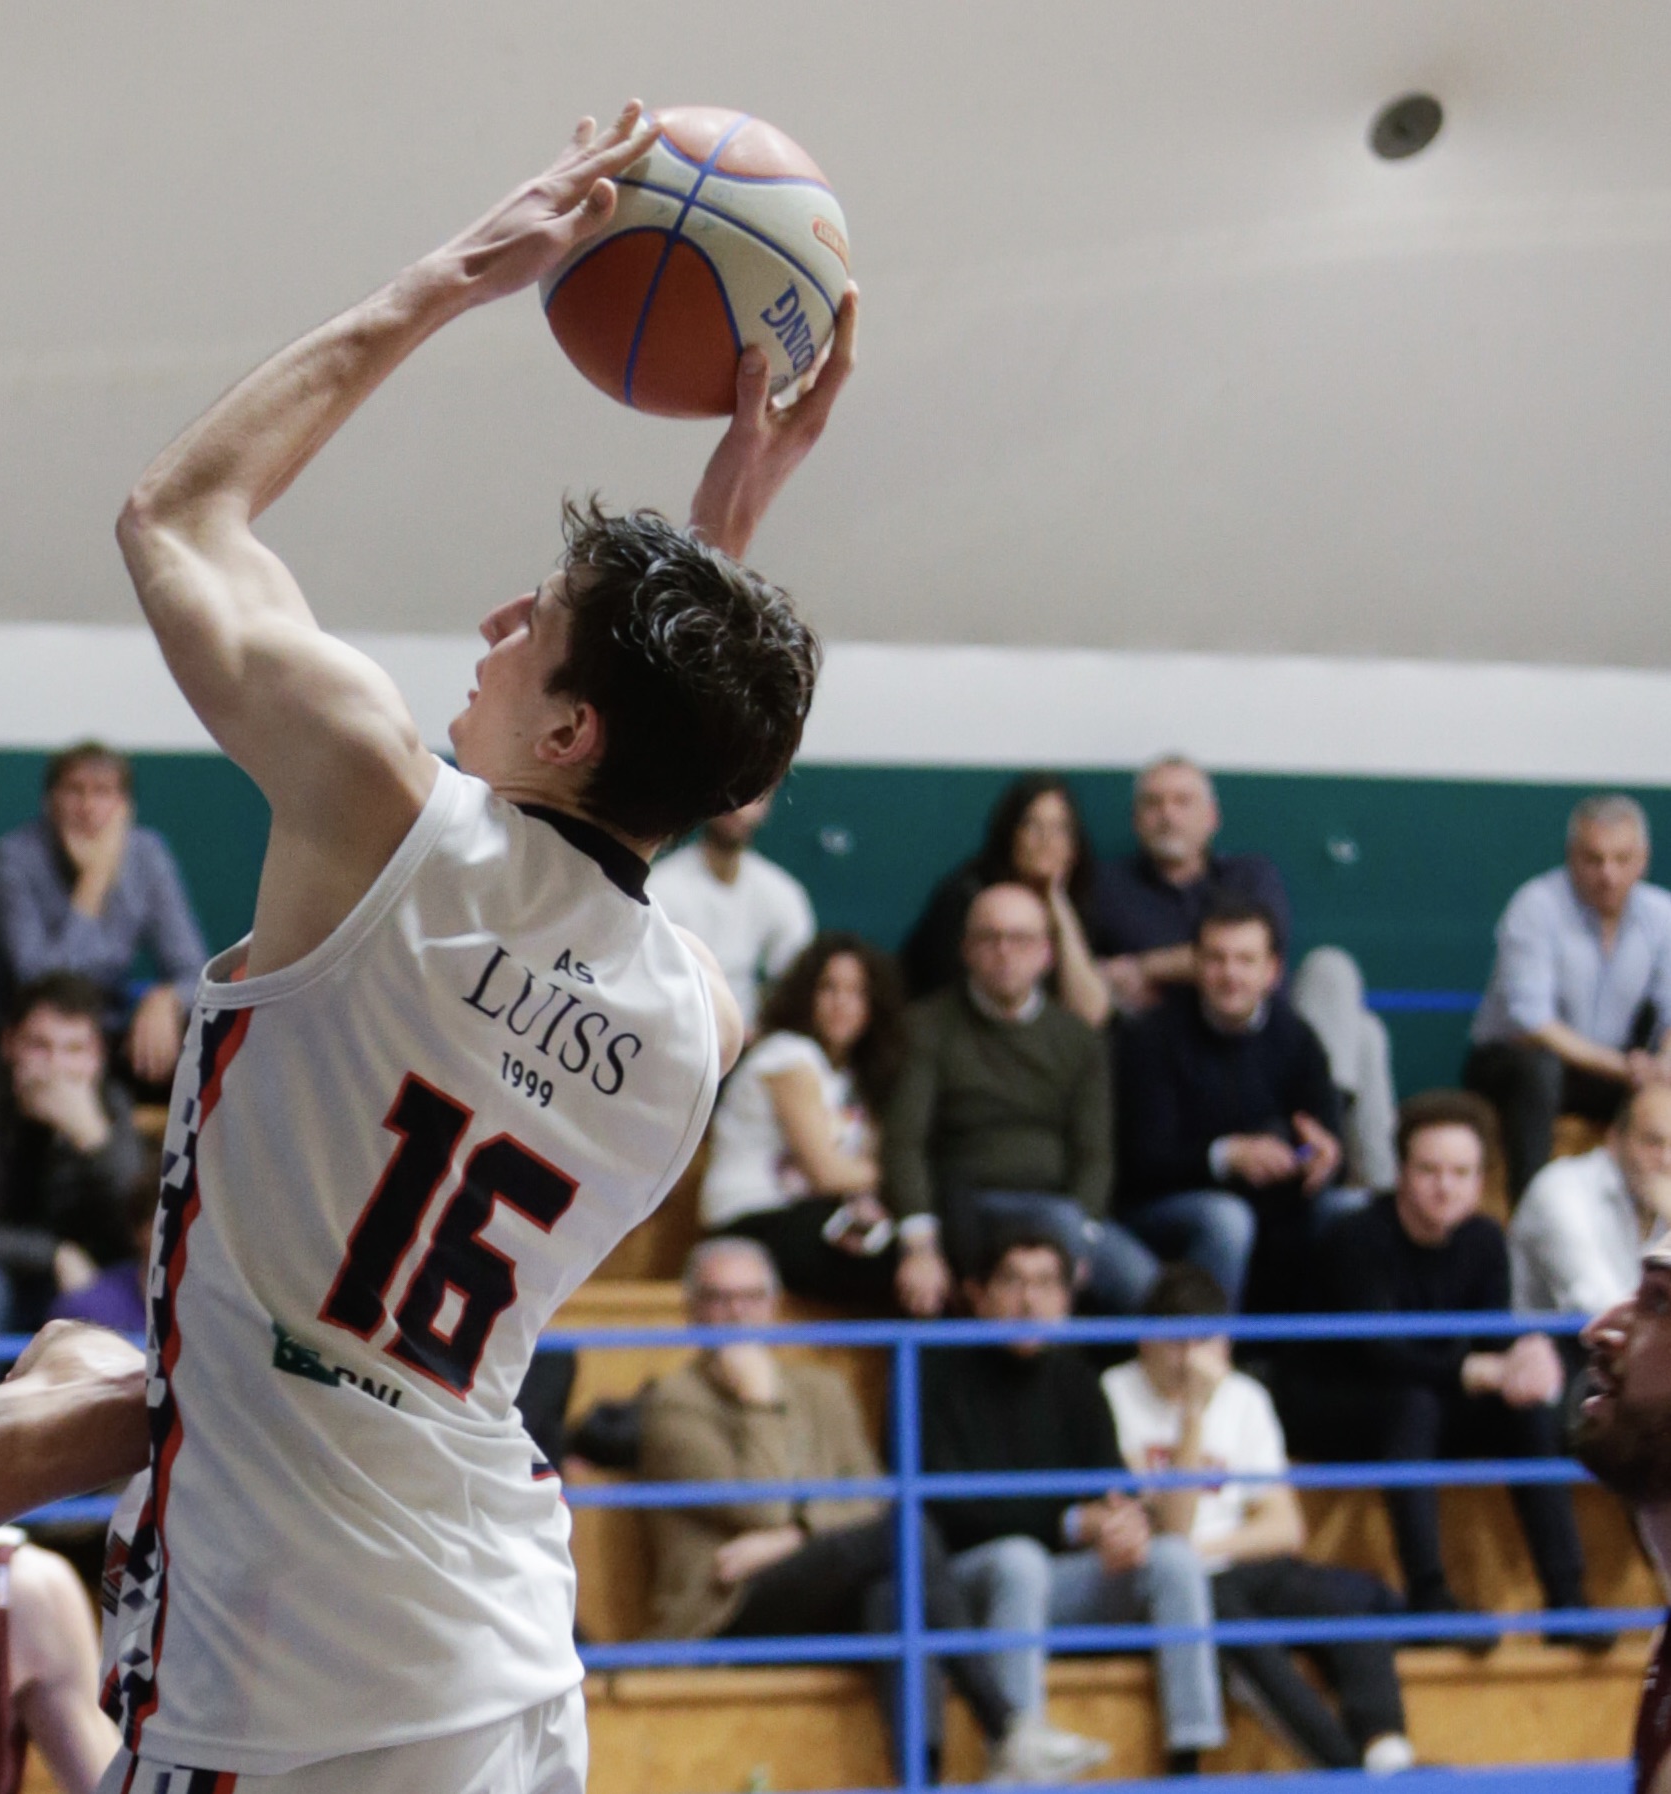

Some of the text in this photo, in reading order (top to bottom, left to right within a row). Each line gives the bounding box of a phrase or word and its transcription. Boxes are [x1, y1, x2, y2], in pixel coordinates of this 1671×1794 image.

[760, 280, 816, 376] DING
[552, 948, 595, 985] AS
[462, 946, 642, 1096] LUISS
[501, 1051, 554, 1107] 1999
[317, 1071, 580, 1402] 16
